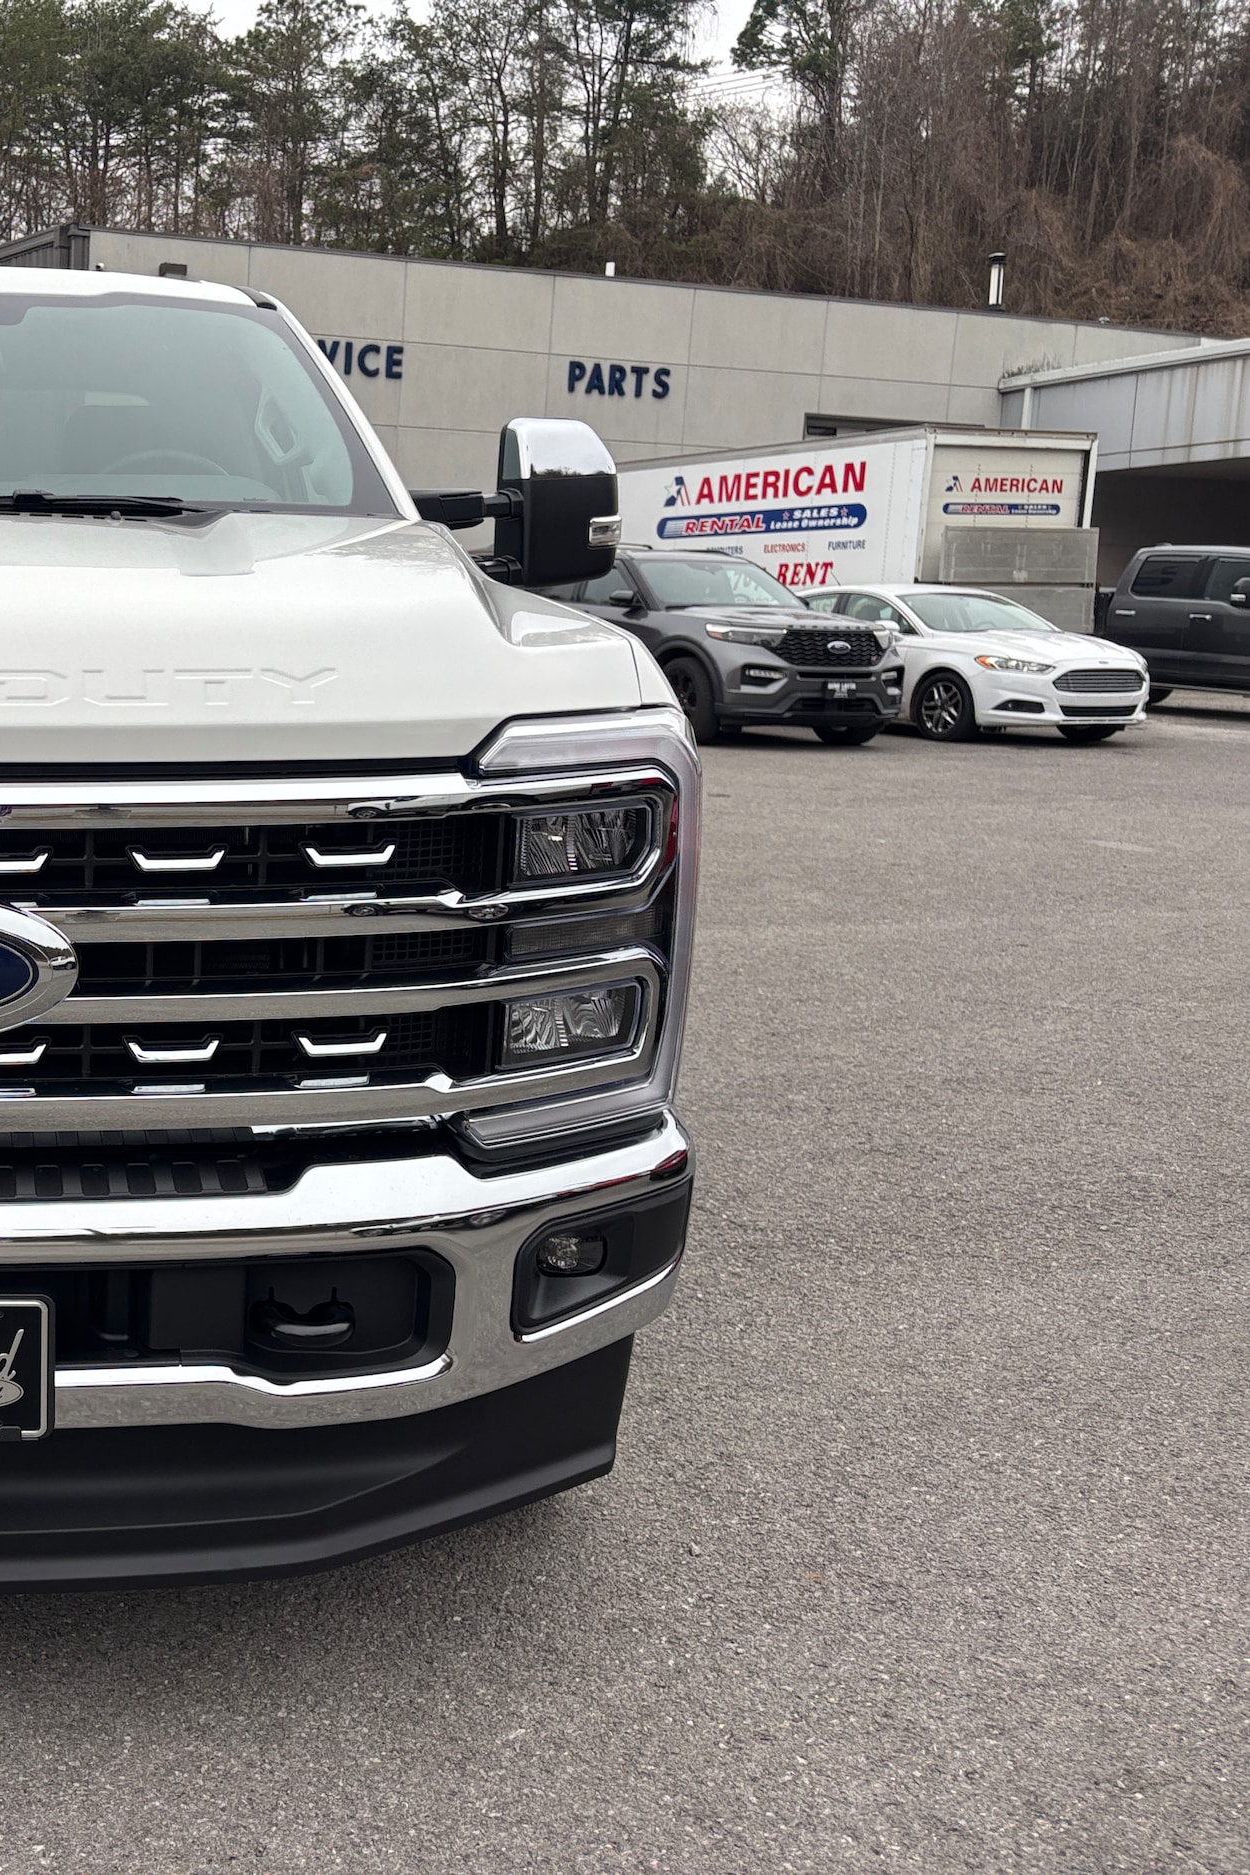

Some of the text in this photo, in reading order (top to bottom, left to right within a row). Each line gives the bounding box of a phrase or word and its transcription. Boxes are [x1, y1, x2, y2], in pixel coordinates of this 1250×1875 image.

[567, 360, 671, 399] PARTS
[695, 461, 867, 505] AMERICAN
[970, 477, 1064, 494] AMERICAN
[793, 507, 839, 520] SALES
[684, 515, 766, 535] RENTAL
[770, 516, 859, 530] Lease Ownership
[763, 542, 806, 553] ELECTRONICS
[828, 540, 866, 550] FURNITURE
[778, 561, 834, 587] RENT
